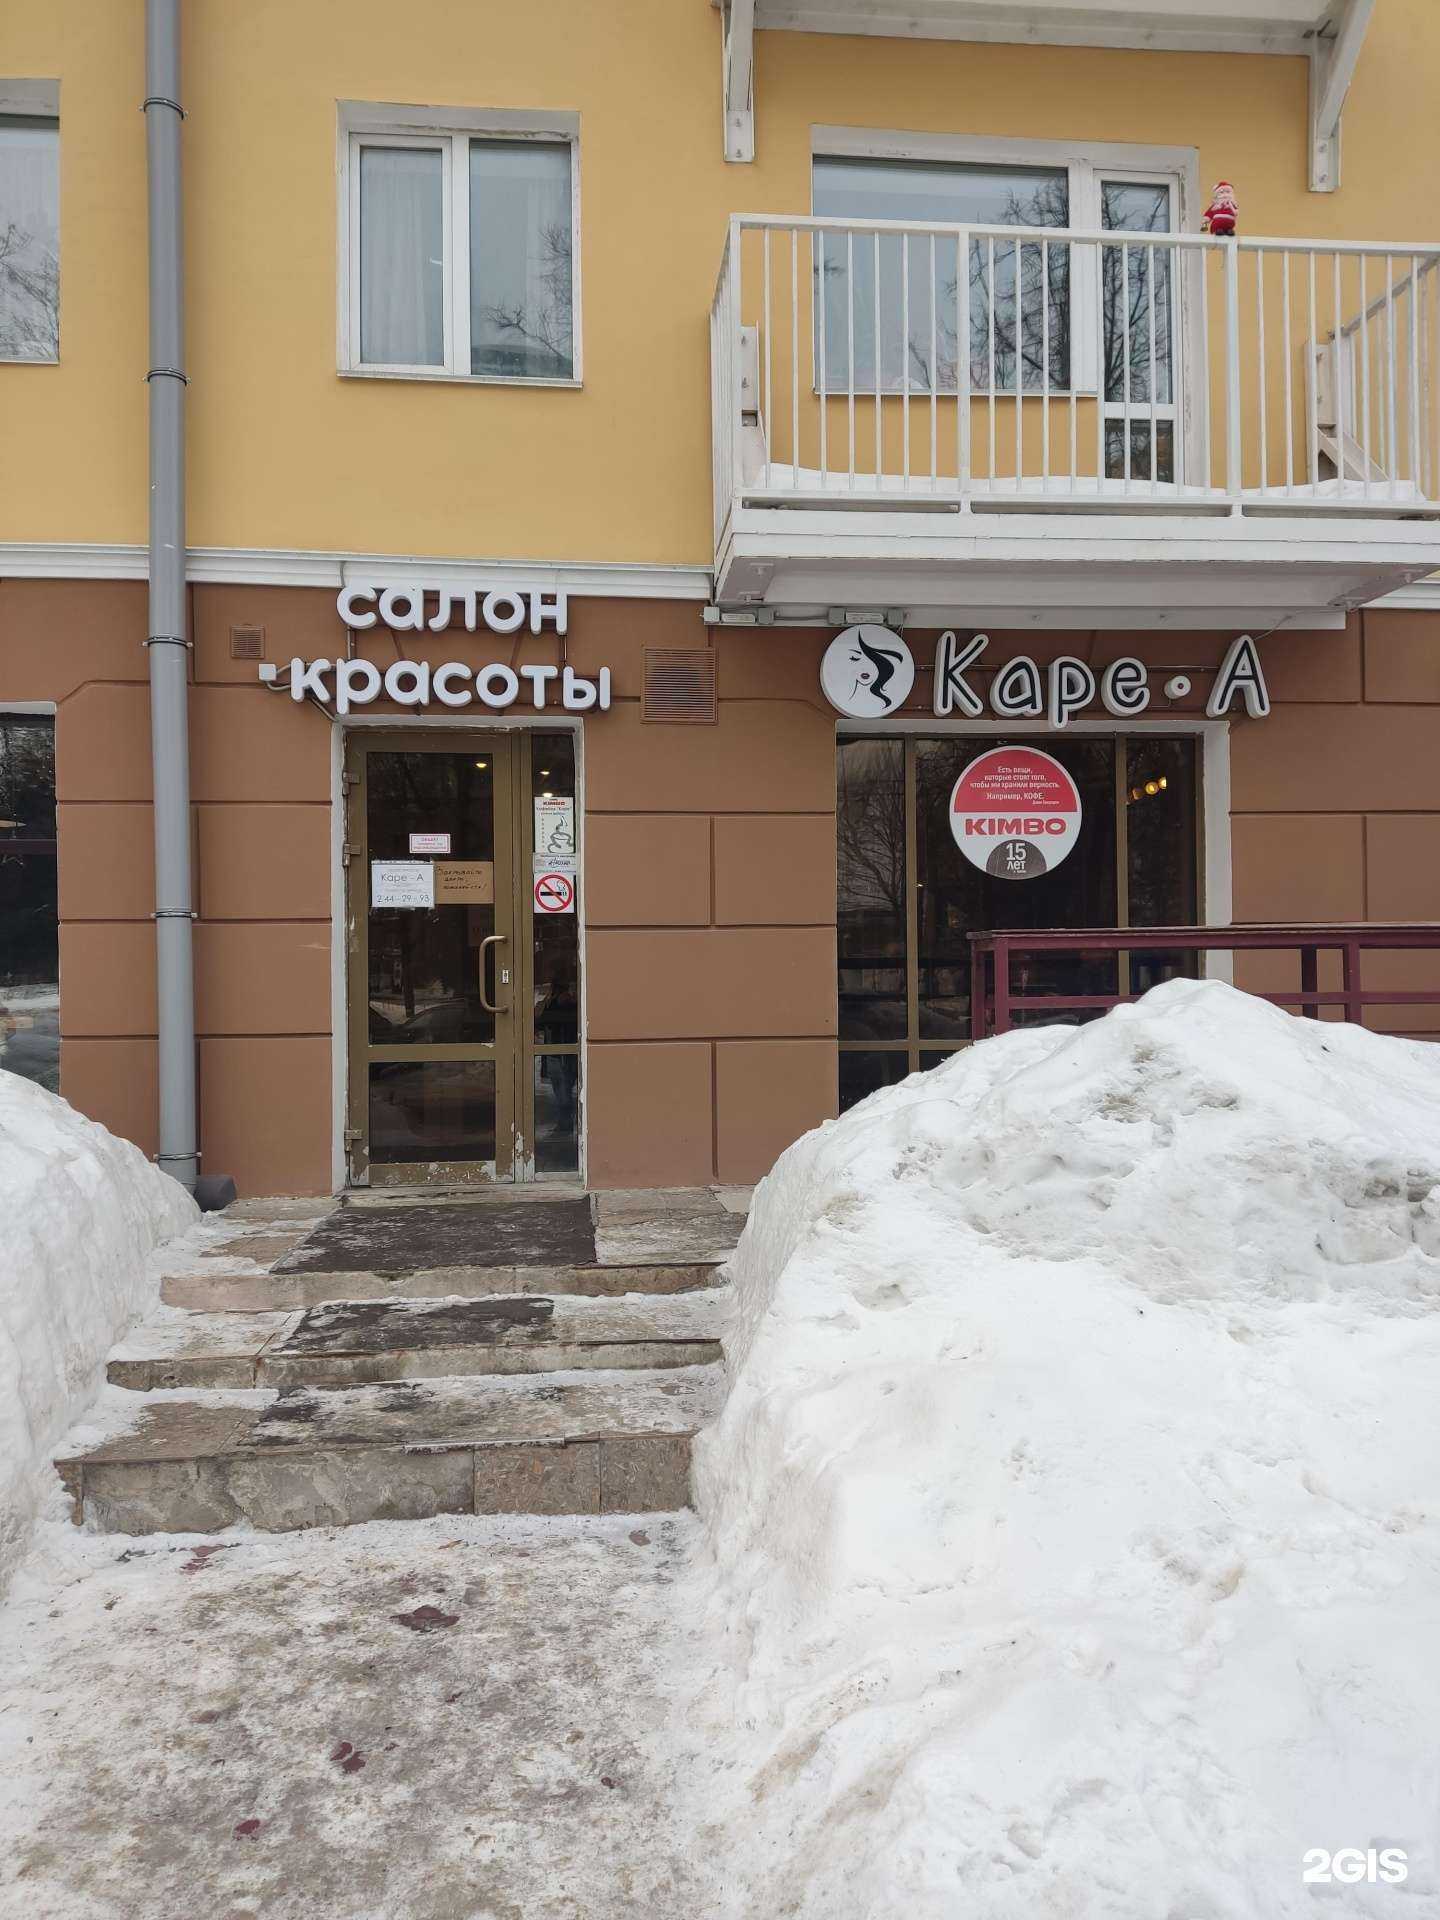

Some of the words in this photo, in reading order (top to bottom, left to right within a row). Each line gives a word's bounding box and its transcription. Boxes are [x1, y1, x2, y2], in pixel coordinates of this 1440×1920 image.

[337, 584, 567, 635] салон
[290, 657, 611, 715] красоты
[933, 630, 1151, 729] Каре
[964, 817, 1067, 836] KIMBO
[1006, 842, 1027, 861] 15
[1006, 860, 1027, 871] лет
